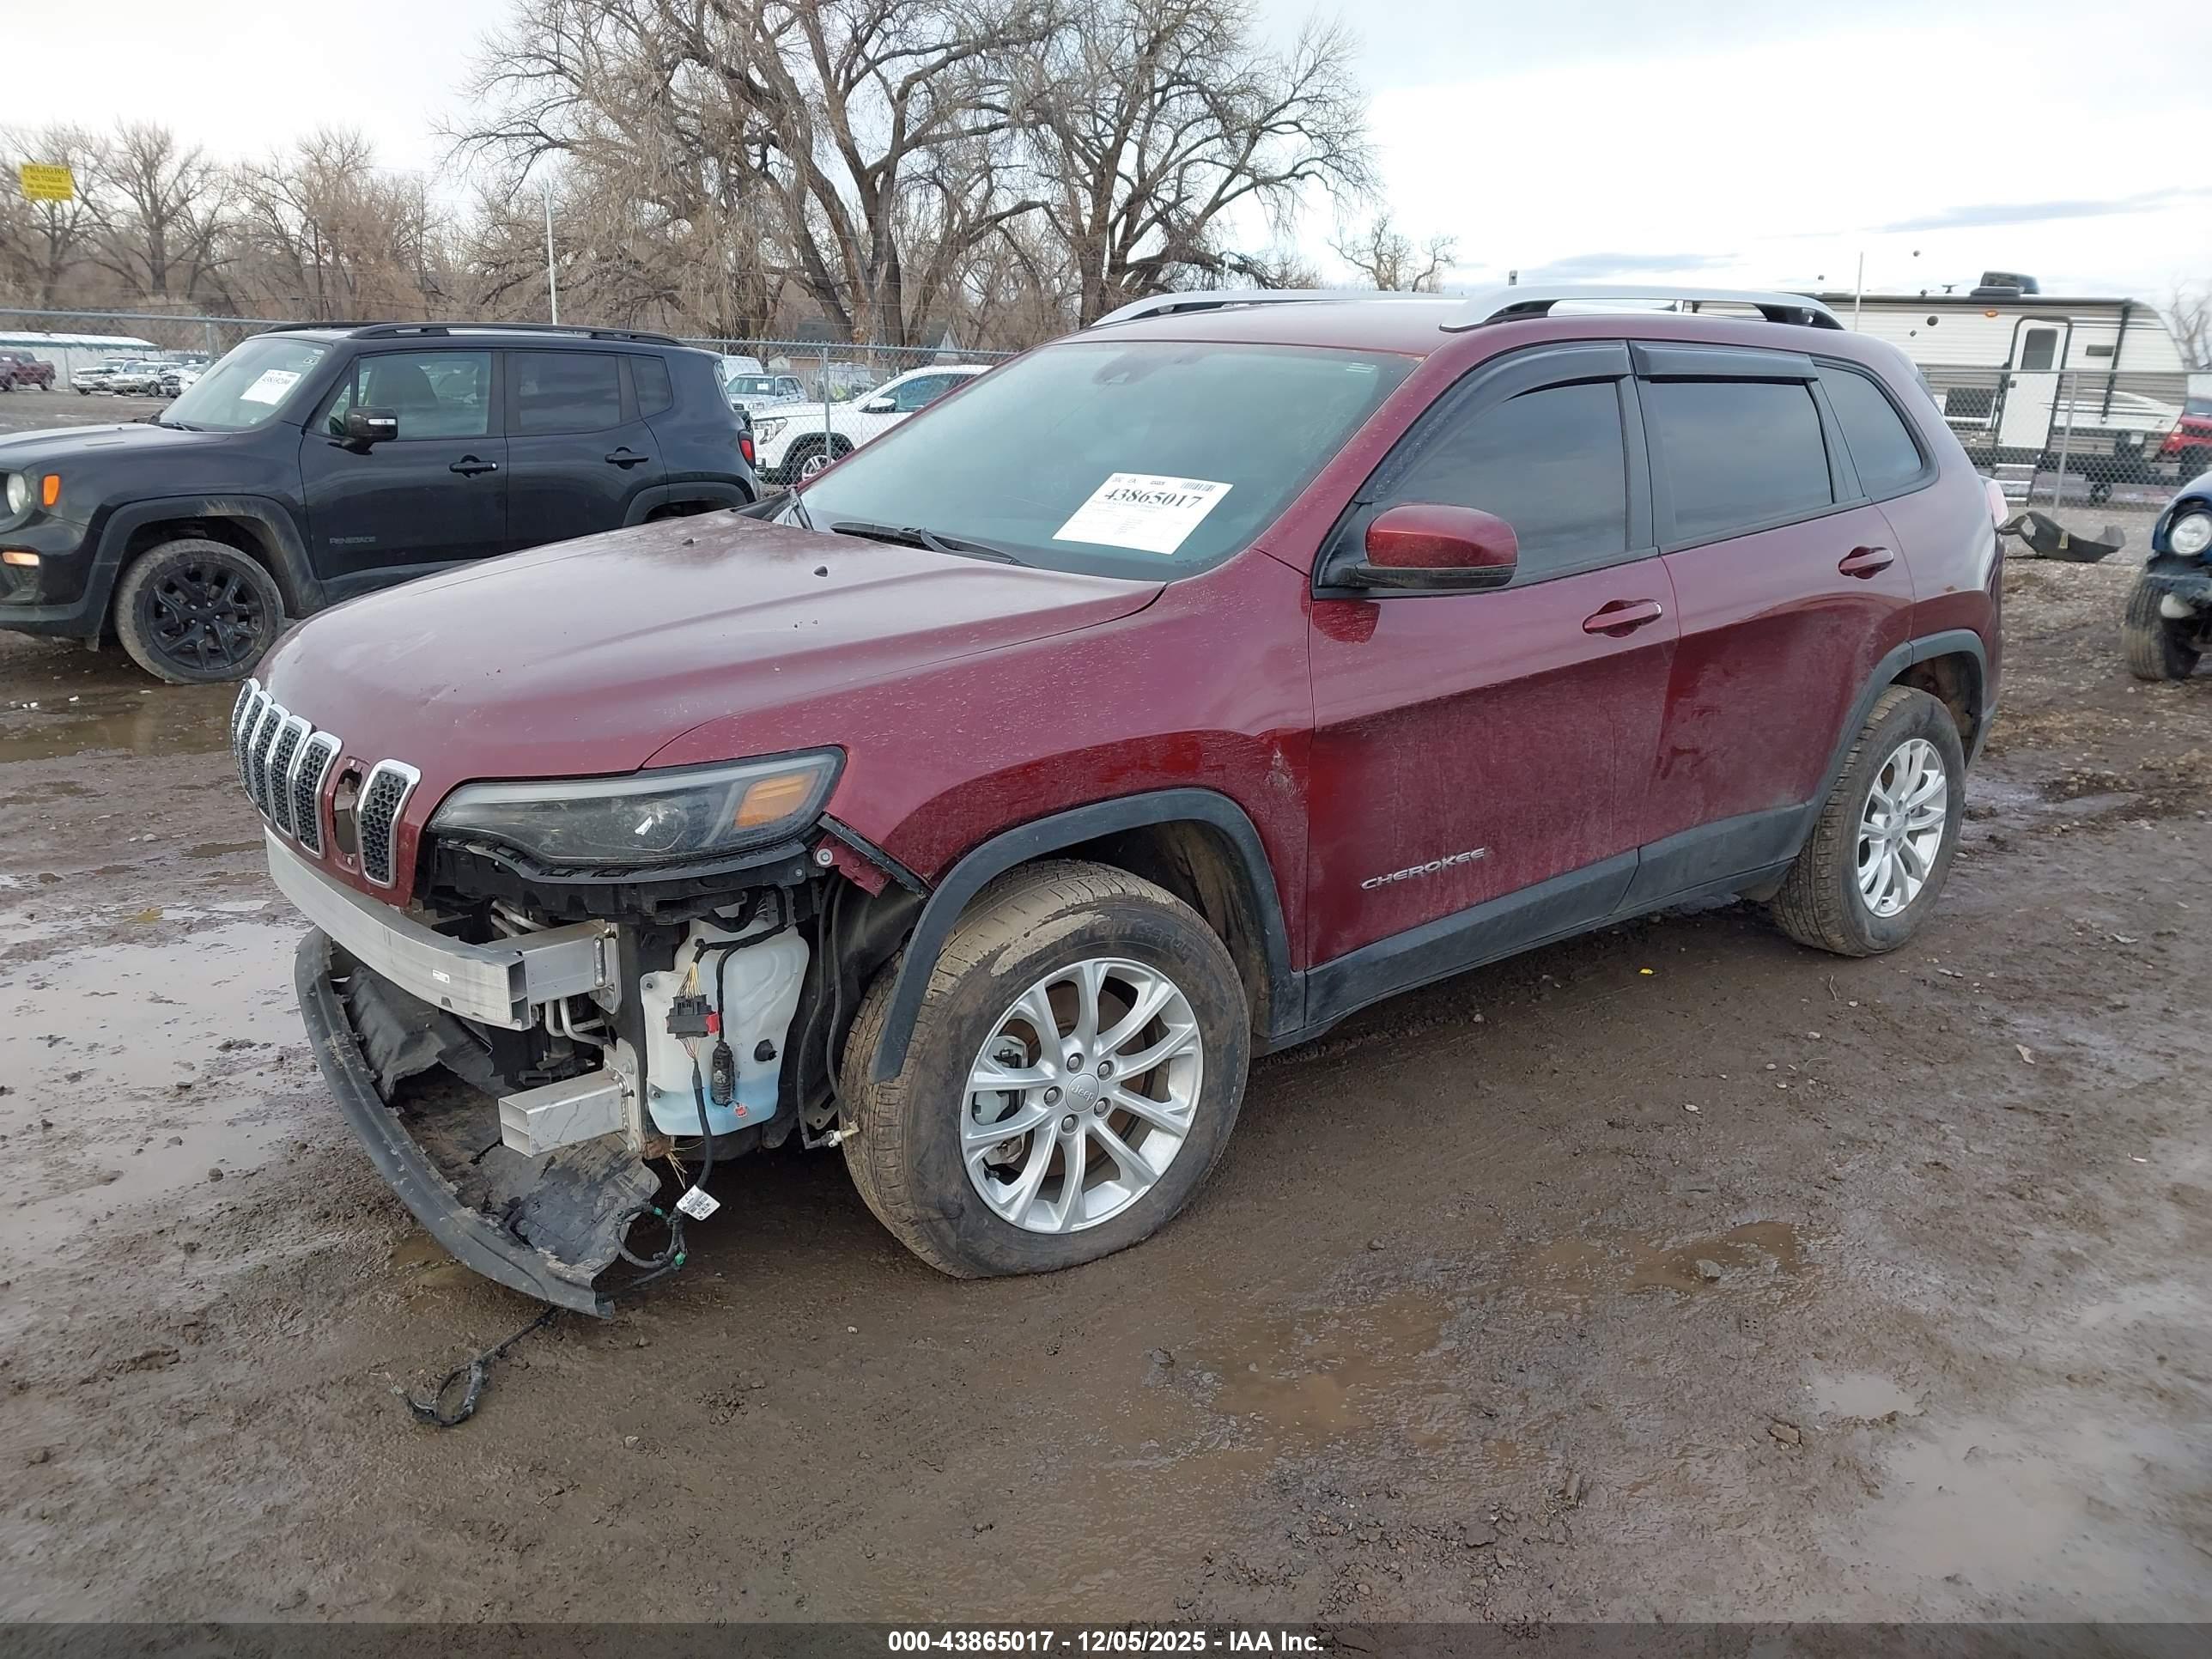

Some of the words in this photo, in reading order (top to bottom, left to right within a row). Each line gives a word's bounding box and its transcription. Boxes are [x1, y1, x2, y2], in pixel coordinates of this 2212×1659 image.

[22, 165, 70, 175] PELIGRO
[1104, 488, 1203, 508] 43865017
[1360, 847, 1486, 890] CHEROKEE
[1071, 1085, 1095, 1102] Jeep
